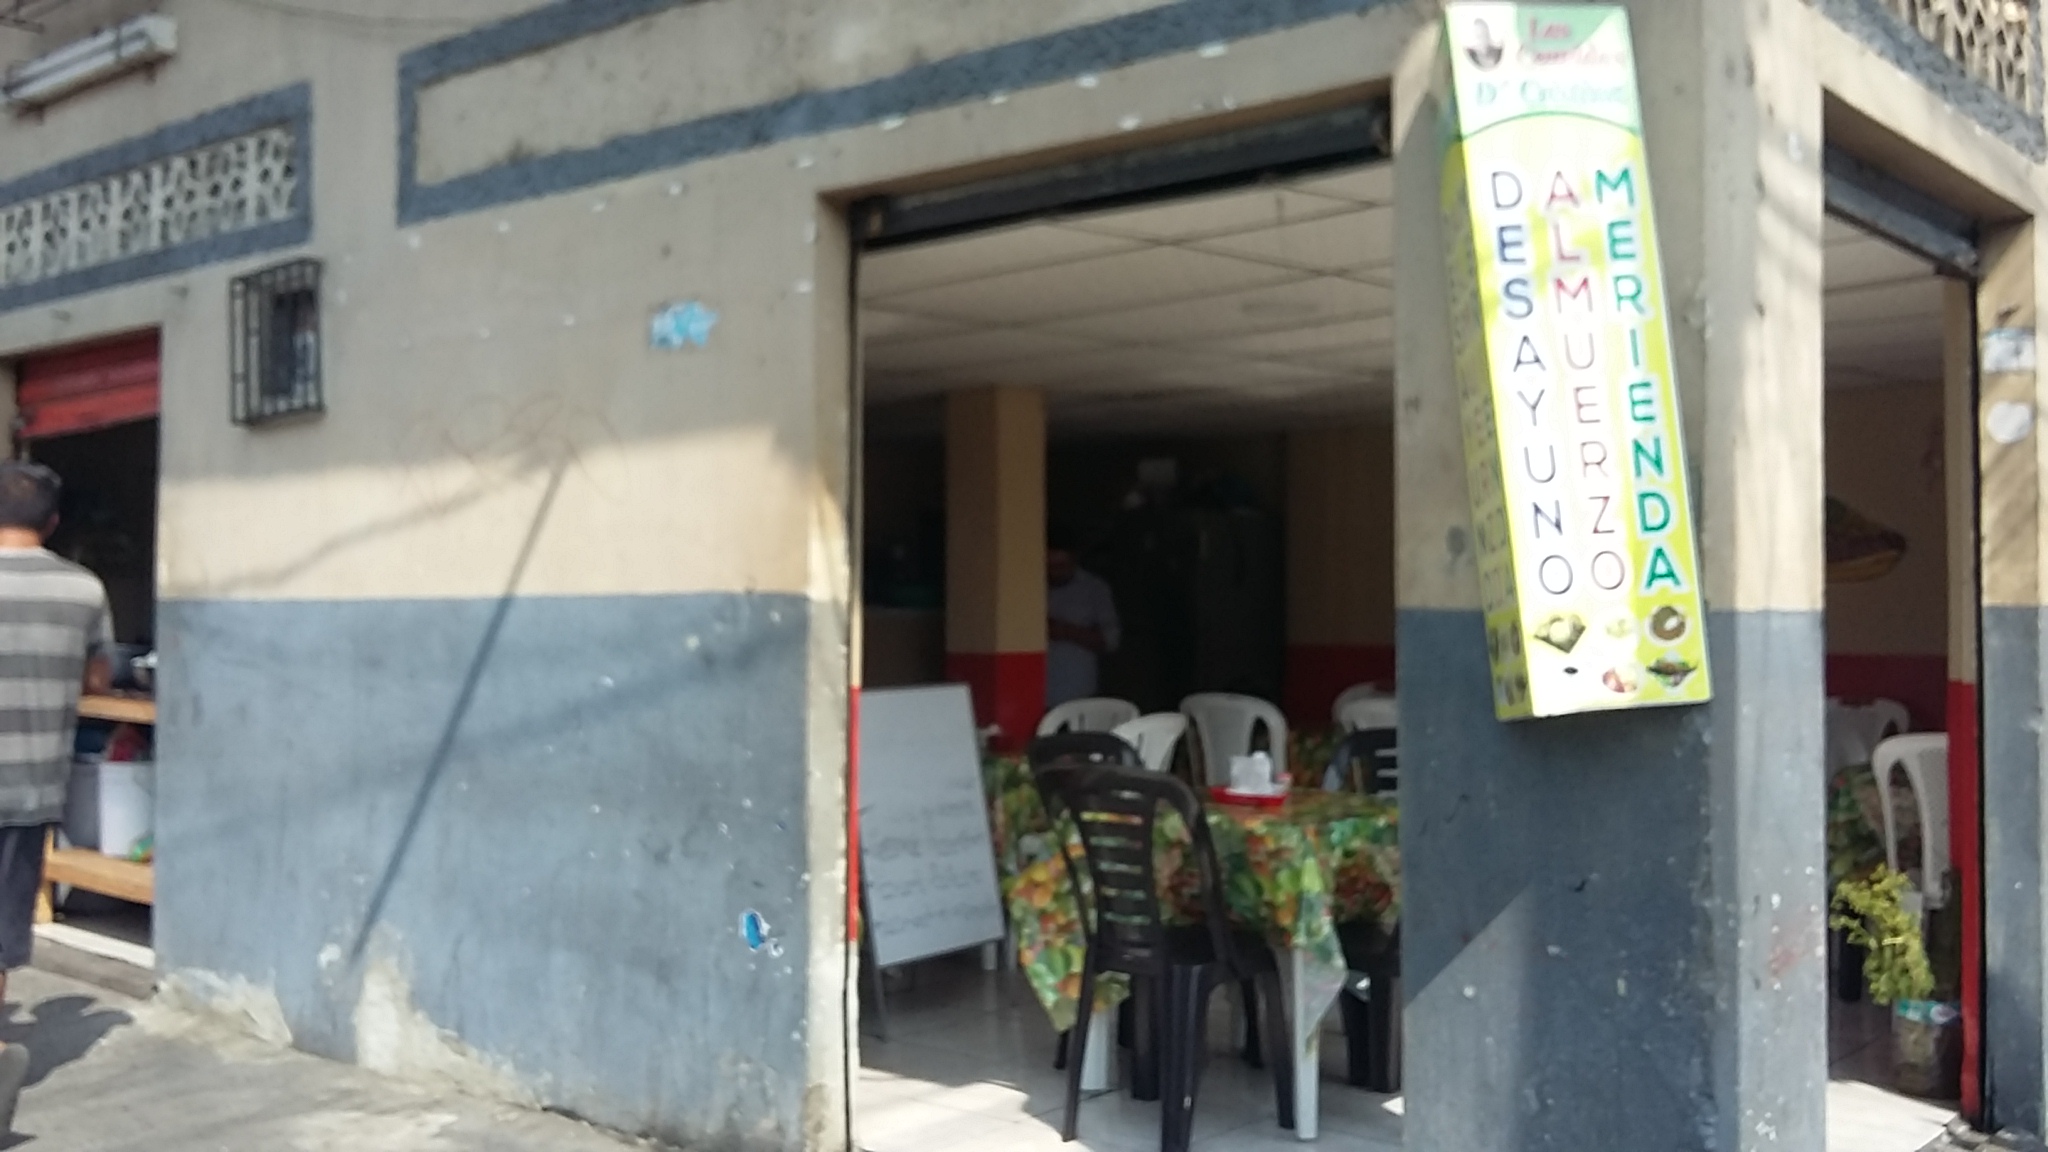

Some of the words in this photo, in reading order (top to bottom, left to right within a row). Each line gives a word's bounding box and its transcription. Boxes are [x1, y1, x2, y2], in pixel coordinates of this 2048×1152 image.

[1491, 170, 1574, 595] DESAYUNO
[1545, 169, 1626, 591] ALMUERZO
[1594, 165, 1682, 591] MERIENDA
